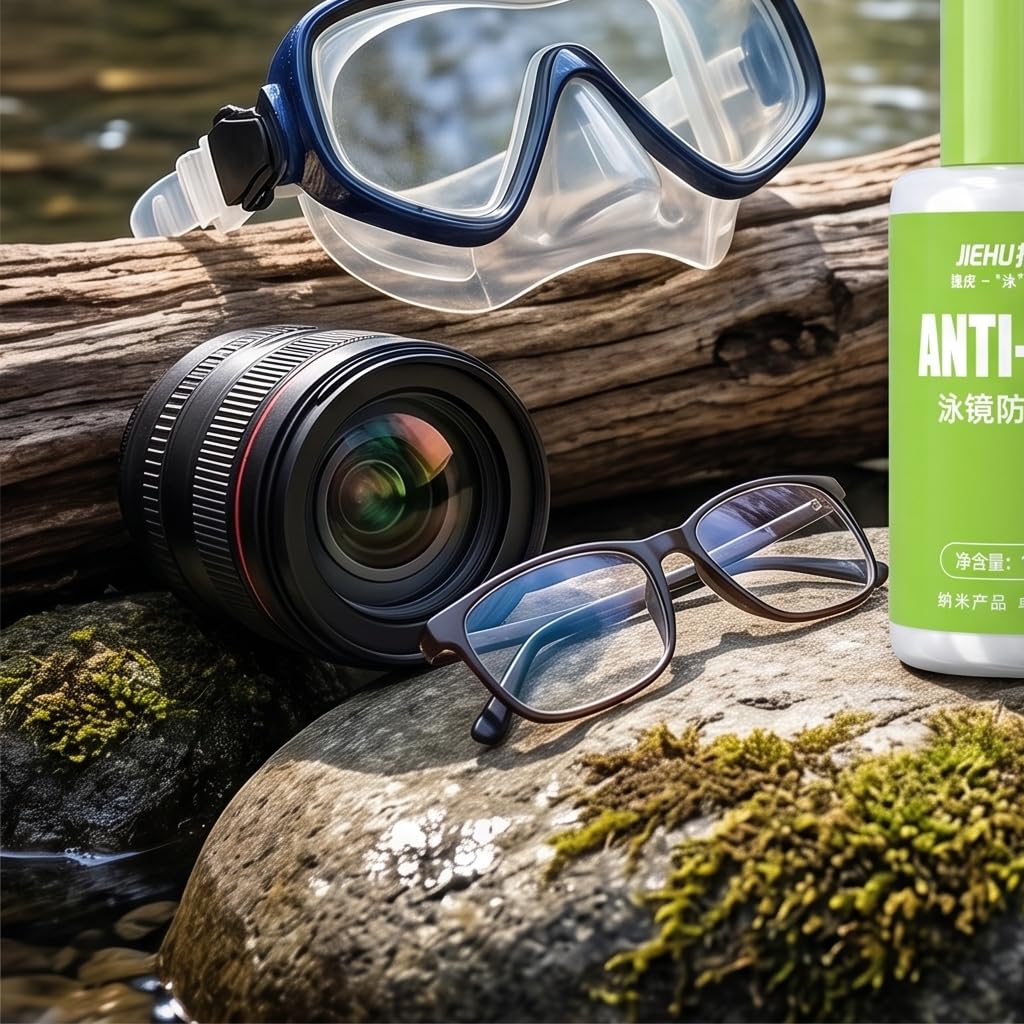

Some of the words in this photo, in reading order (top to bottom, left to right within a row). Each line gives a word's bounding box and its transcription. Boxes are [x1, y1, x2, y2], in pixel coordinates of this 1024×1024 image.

[955, 243, 1015, 267] JIEHU
[937, 591, 1007, 612] 纳米产品
